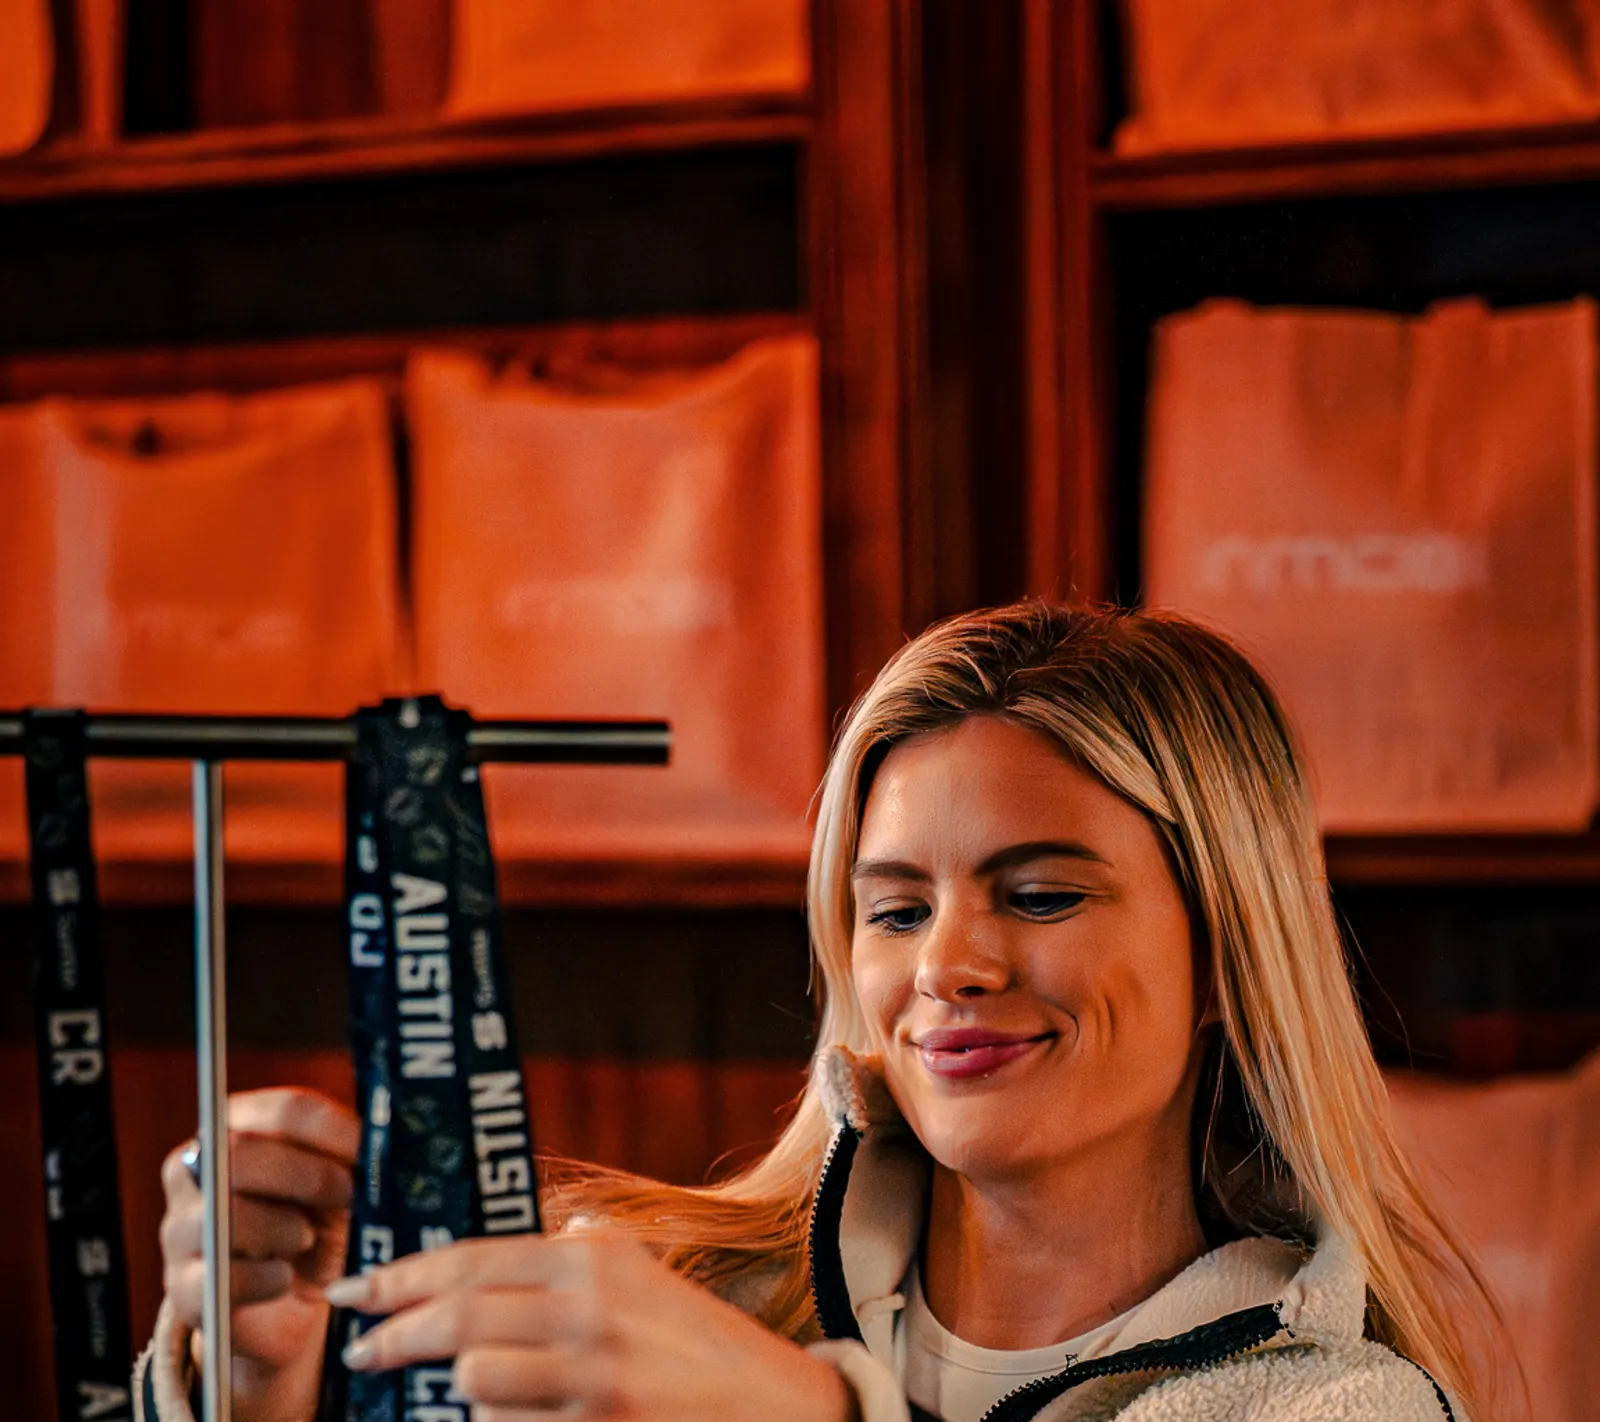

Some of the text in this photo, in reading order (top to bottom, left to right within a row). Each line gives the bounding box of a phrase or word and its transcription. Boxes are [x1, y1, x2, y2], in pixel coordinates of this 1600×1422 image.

[48, 1009, 104, 1085] CR
[391, 873, 457, 1079] AUSTIN
[468, 1070, 536, 1234] USTIN
